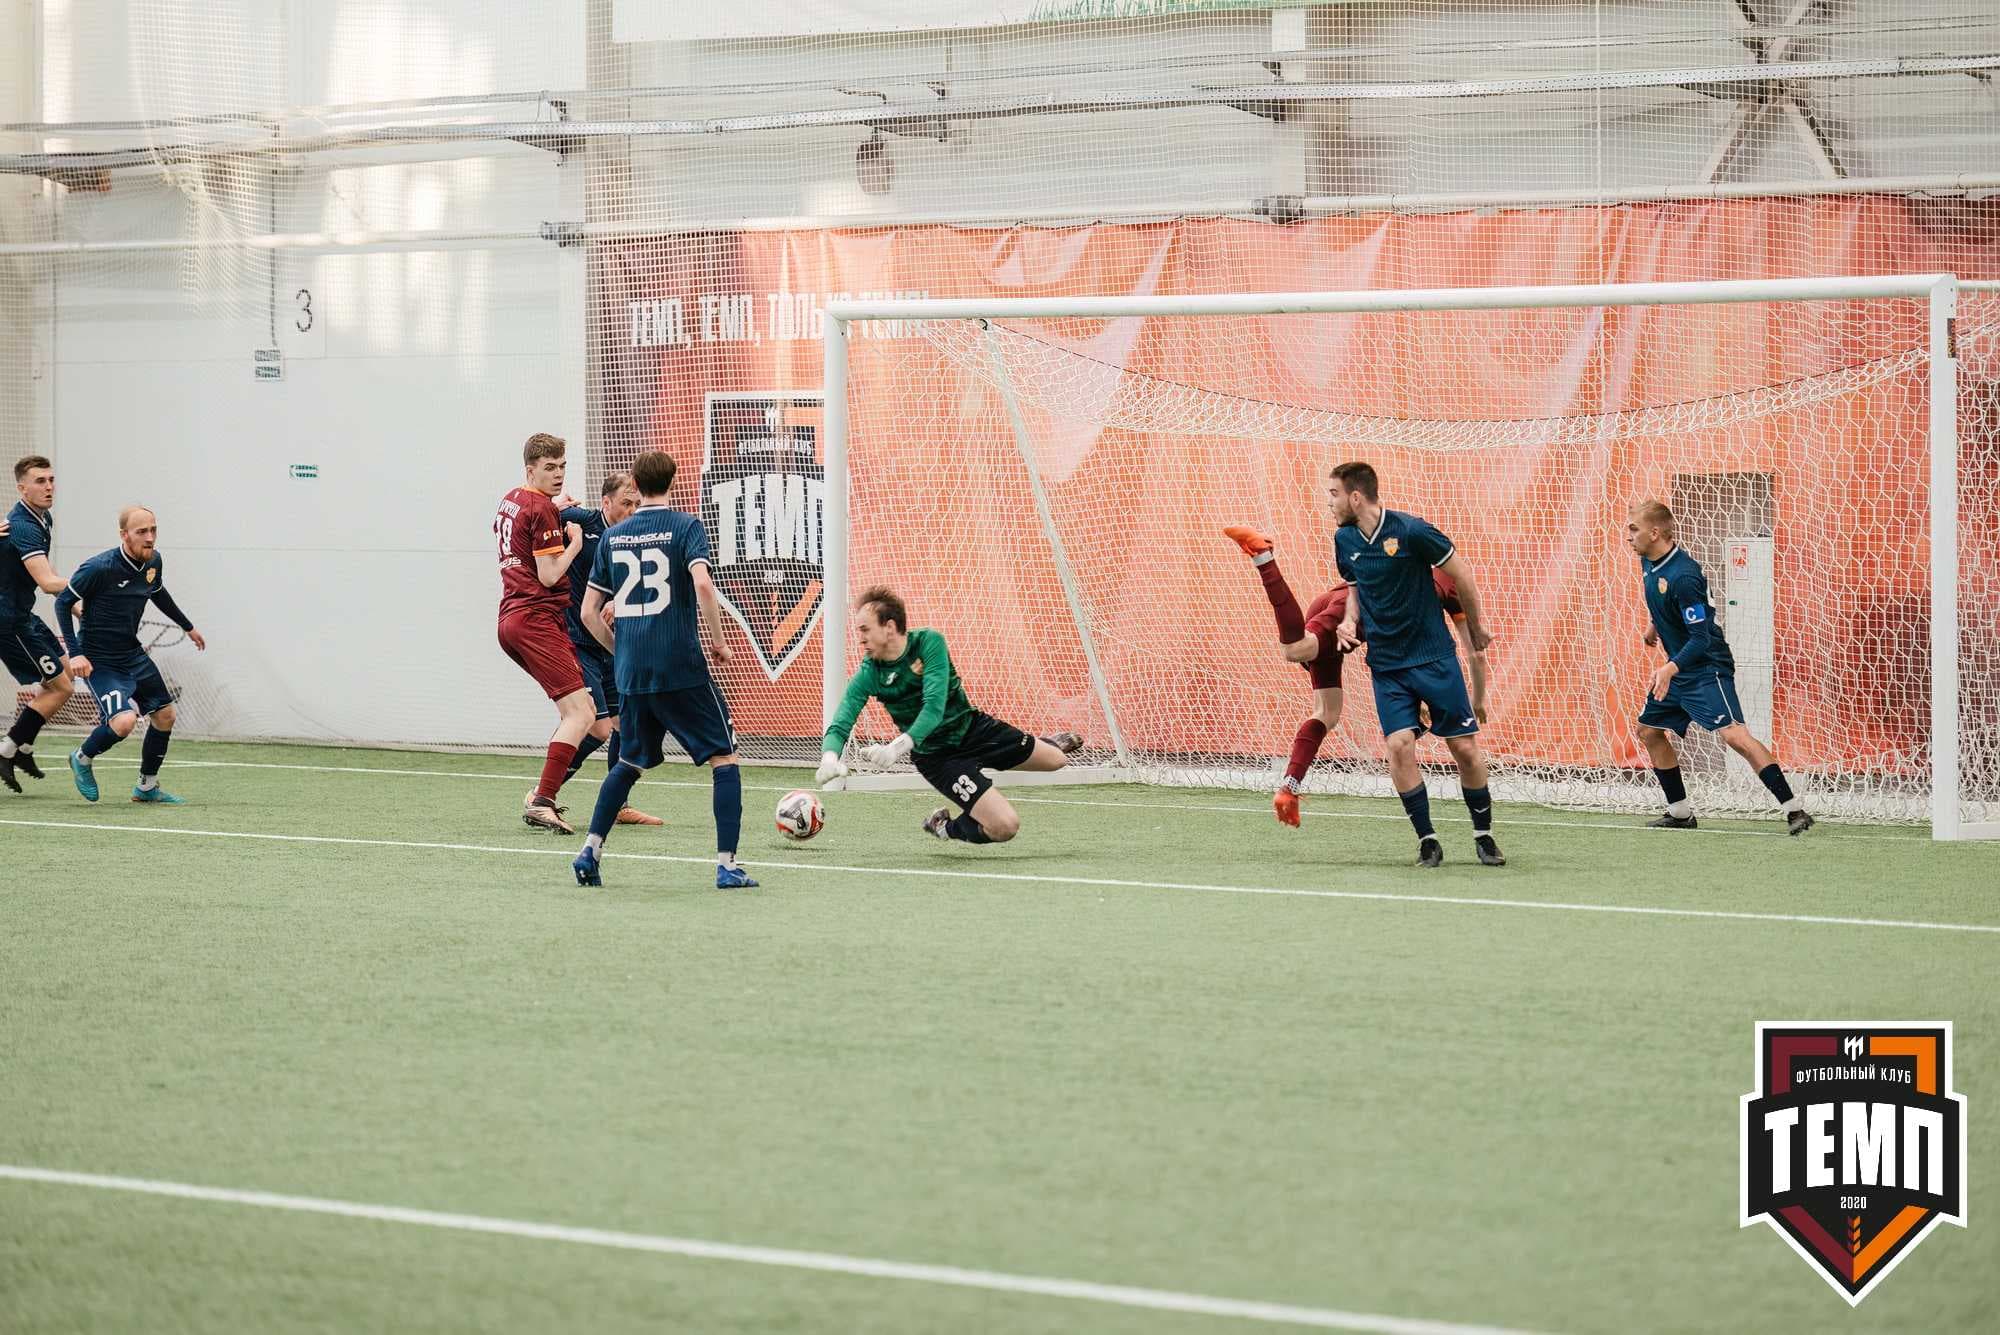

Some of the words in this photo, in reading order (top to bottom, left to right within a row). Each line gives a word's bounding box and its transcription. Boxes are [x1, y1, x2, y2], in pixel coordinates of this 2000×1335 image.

[296, 289, 313, 333] 3
[612, 548, 671, 617] 23
[1685, 607, 1697, 621] C
[39, 655, 57, 675] 6
[952, 774, 978, 802] 33
